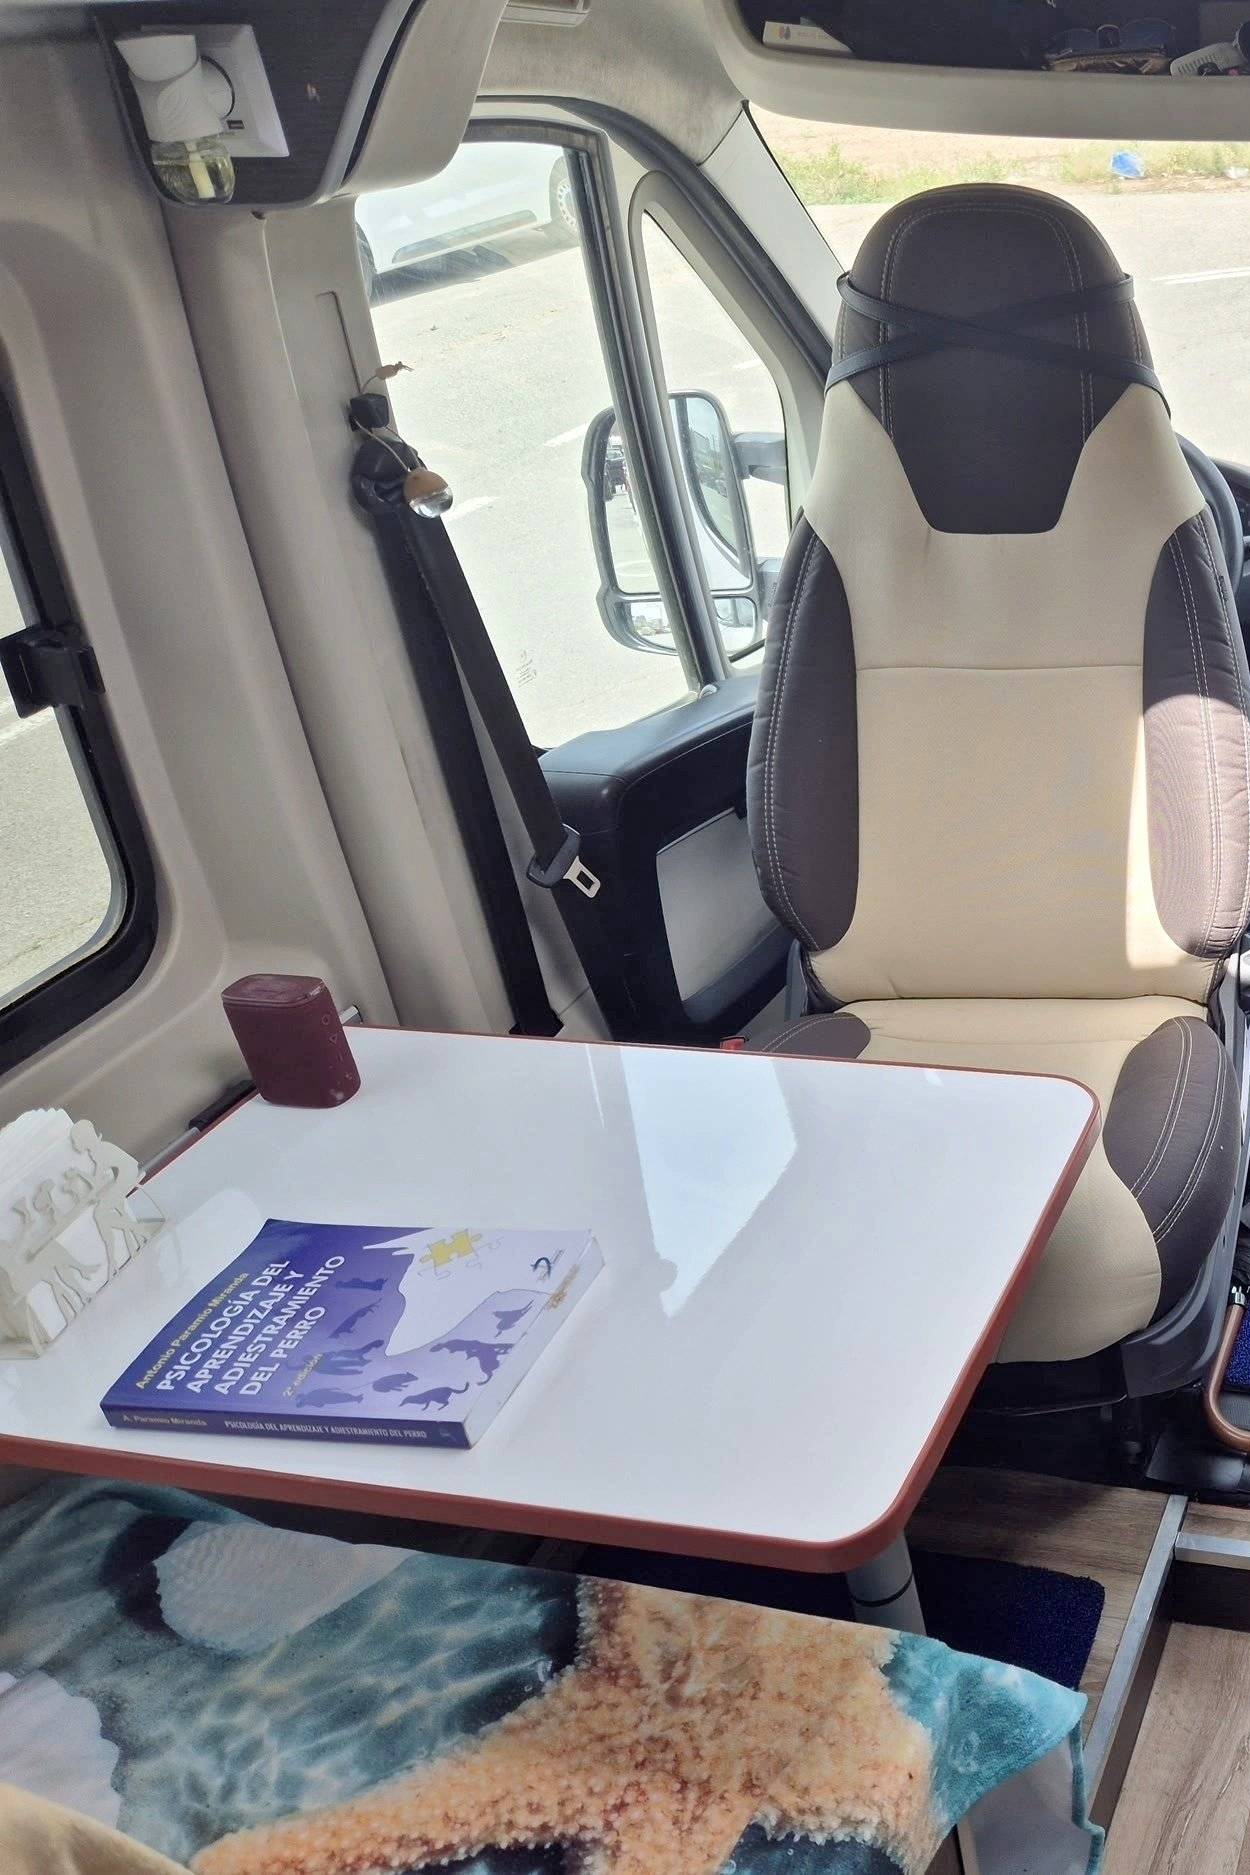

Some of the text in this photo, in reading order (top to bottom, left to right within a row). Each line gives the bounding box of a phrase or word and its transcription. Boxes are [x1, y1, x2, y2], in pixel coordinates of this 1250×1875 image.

[136, 1272, 249, 1390] Antonio Paramio Miranda
[156, 1260, 291, 1390] PSICOLOGÍA DEL
[186, 1270, 305, 1394] APRENDIZAJE Y
[214, 1255, 346, 1395] ADIESTRAMIENTO
[239, 1306, 326, 1396] DEL PERRO
